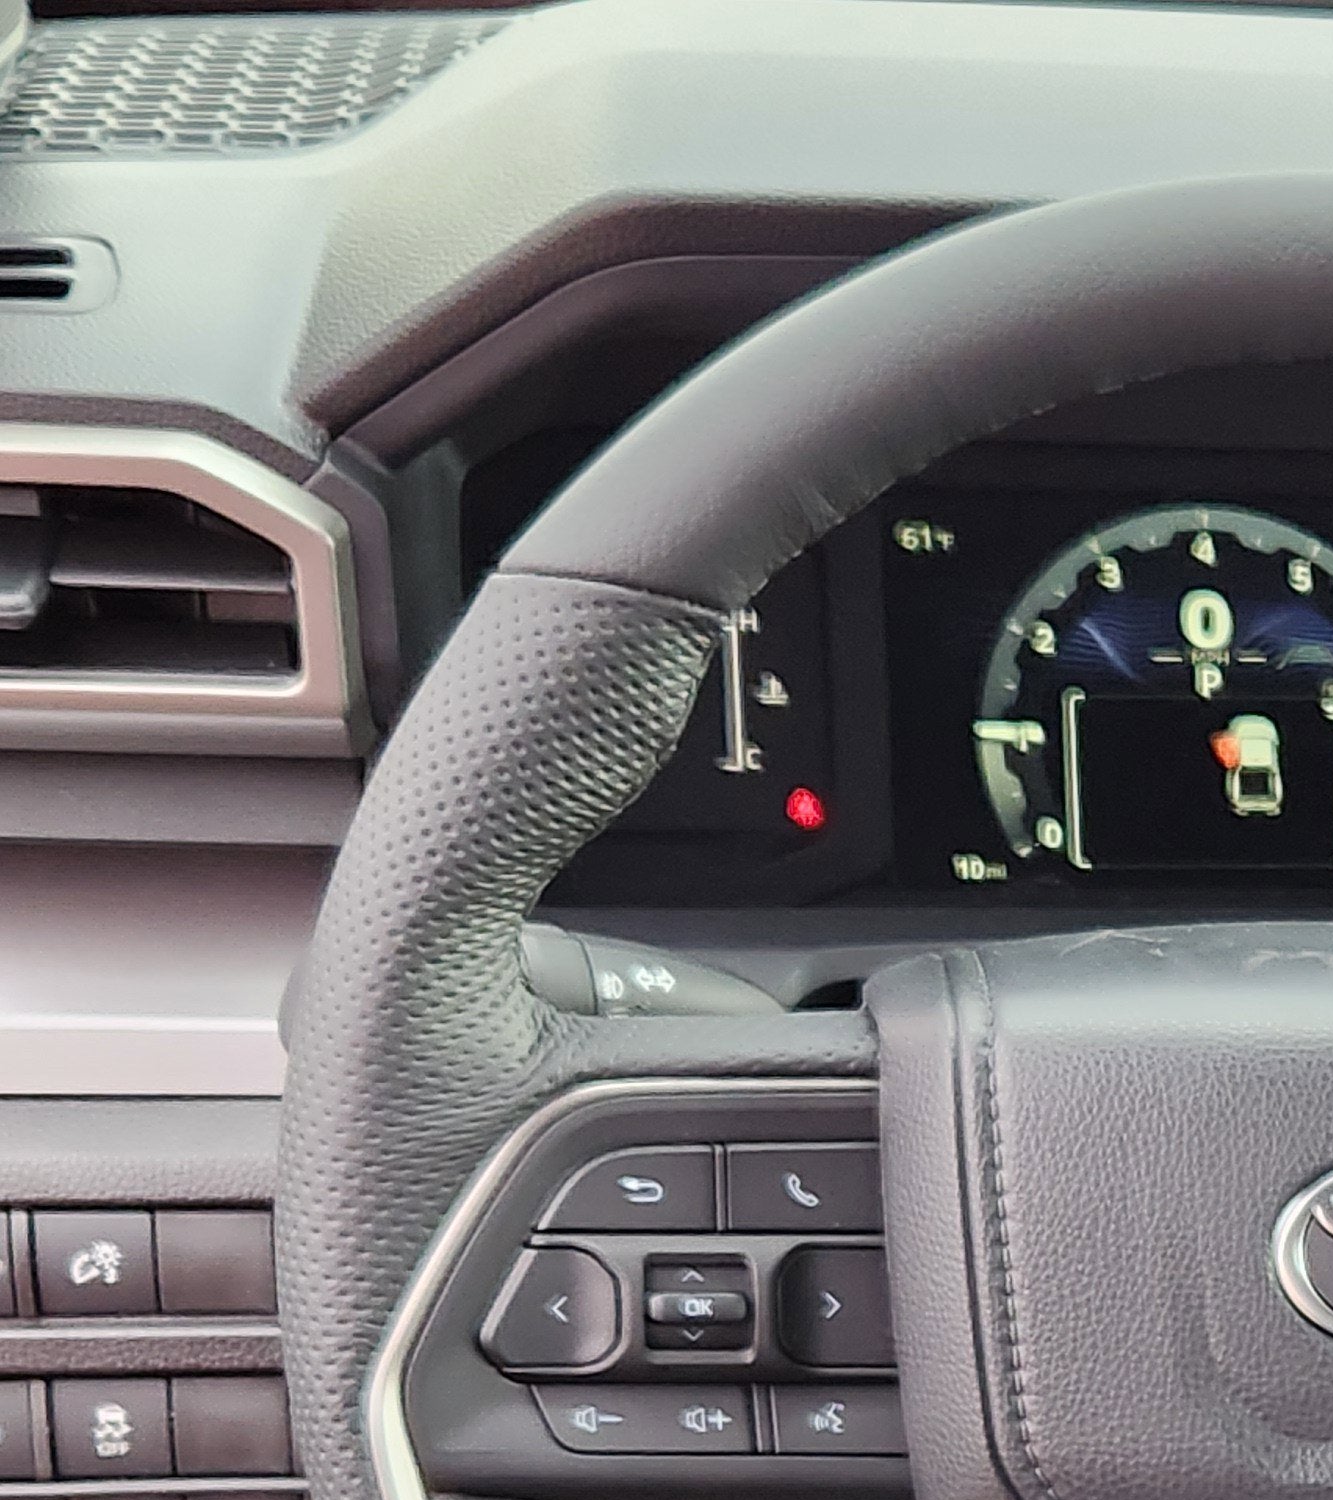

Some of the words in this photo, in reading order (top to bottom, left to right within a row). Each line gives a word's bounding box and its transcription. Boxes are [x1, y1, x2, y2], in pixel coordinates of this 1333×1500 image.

[1189, 532, 1218, 567] 4
[1096, 556, 1124, 592] 3
[1287, 558, 1314, 595] 5
[1180, 588, 1234, 650] 0
[1031, 619, 1057, 656] 2
[1194, 662, 1224, 699] P
[1037, 816, 1063, 850] 0
[681, 1297, 714, 1317] OK
